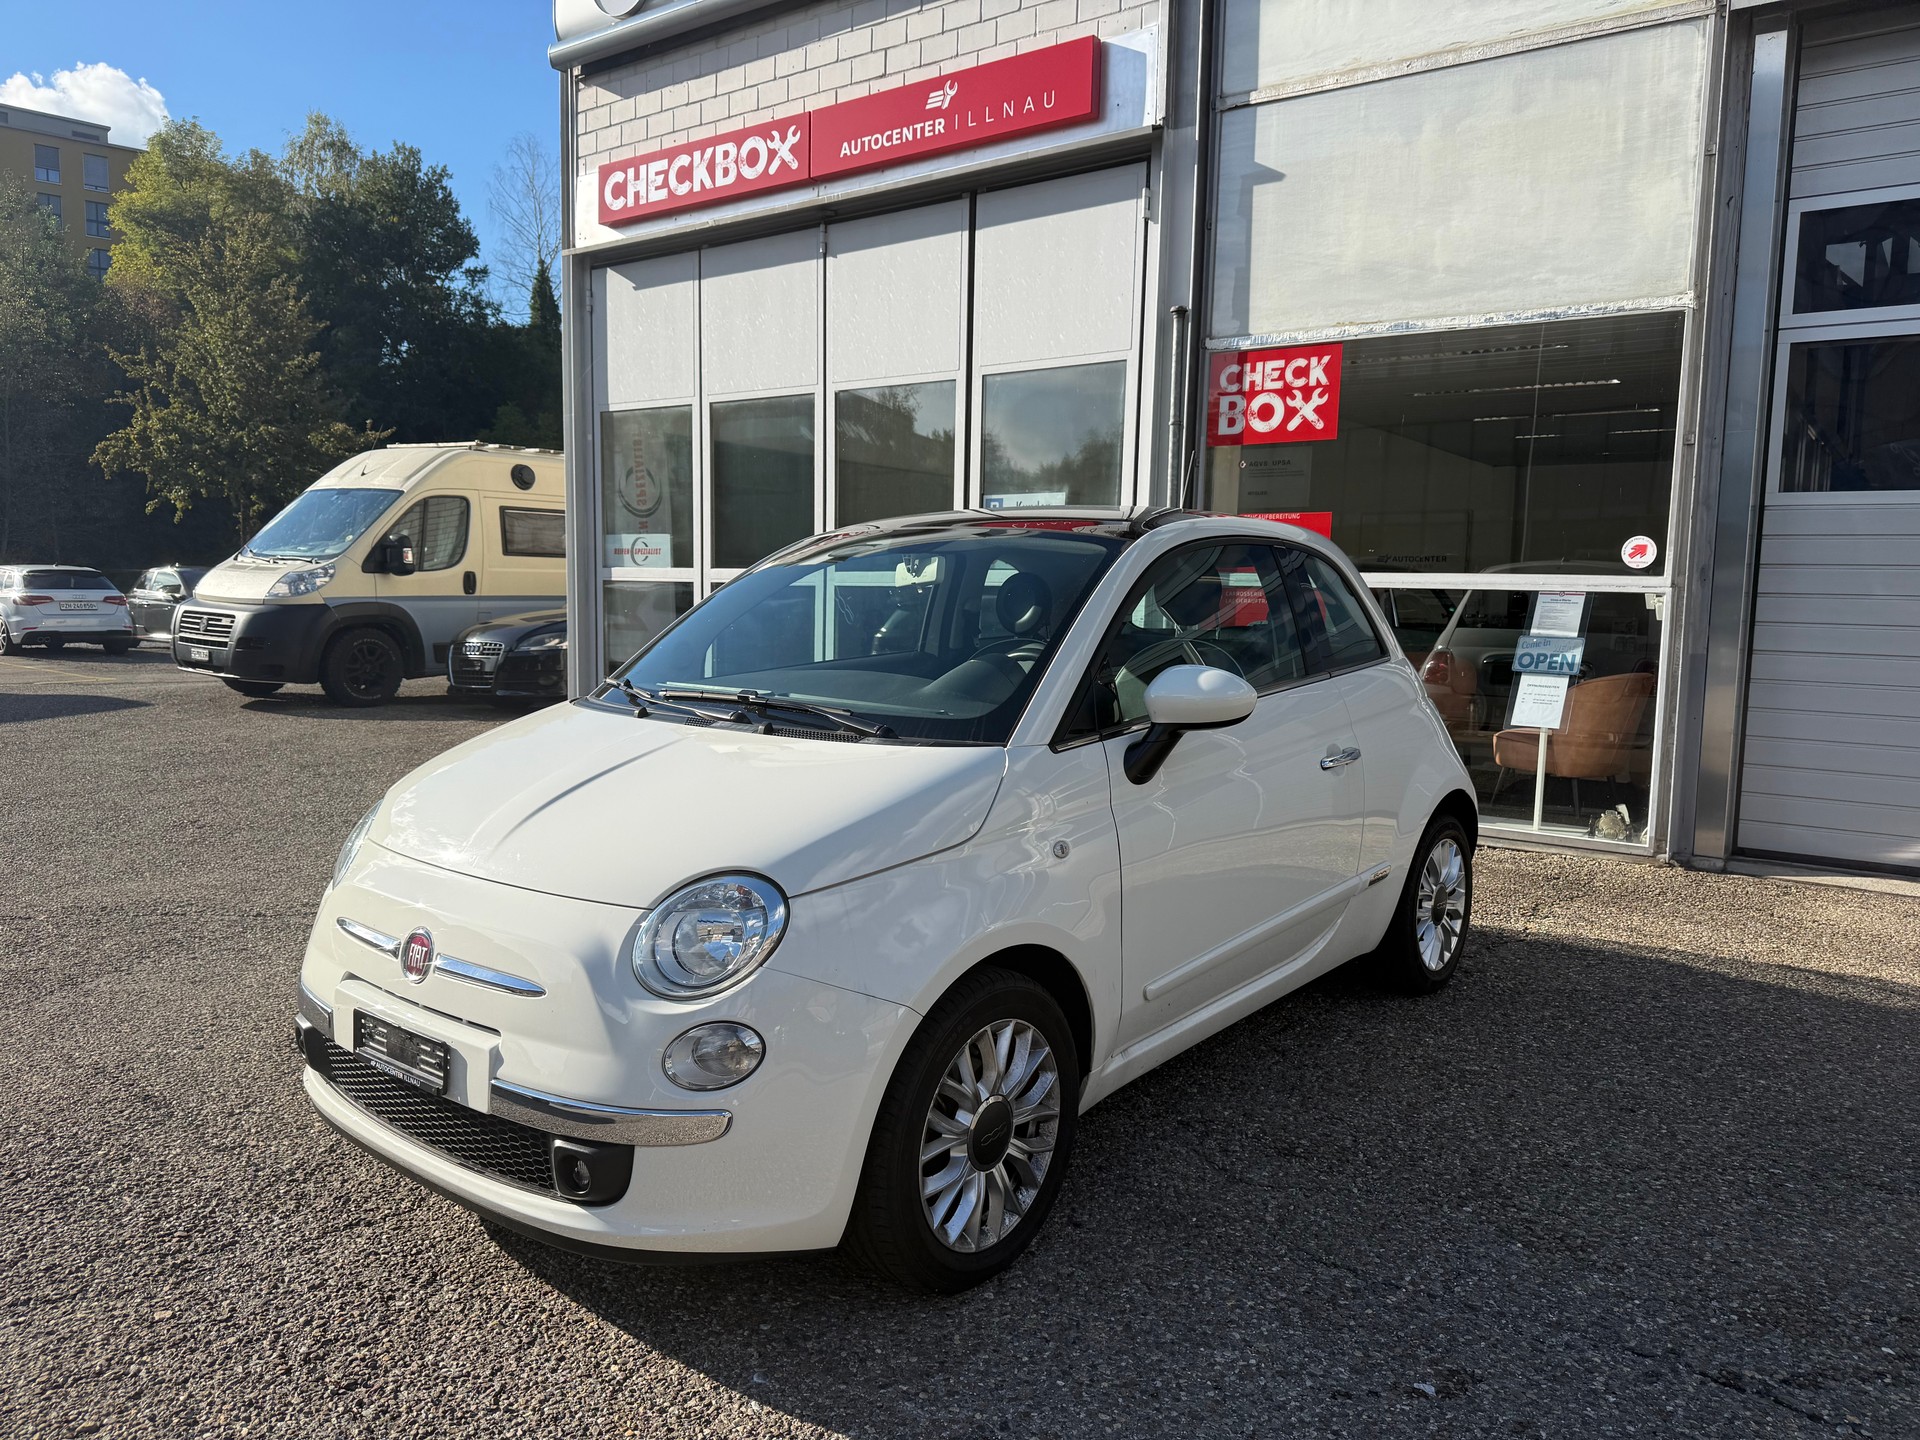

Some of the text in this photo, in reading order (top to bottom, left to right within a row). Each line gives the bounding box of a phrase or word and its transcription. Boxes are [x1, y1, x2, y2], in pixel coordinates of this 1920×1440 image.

[839, 90, 1055, 158] AUTOCENTER ILLNAU
[604, 125, 801, 211] CHECKBOX
[1219, 355, 1332, 393] CHECK
[1218, 387, 1329, 436] BOX
[1391, 555, 1447, 563] AUTOCENTER
[1521, 640, 1541, 650] Come
[1517, 652, 1577, 672] OPEN
[407, 943, 428, 970] FIAT
[375, 1060, 421, 1087] AUTOCENTER ILLNAU
